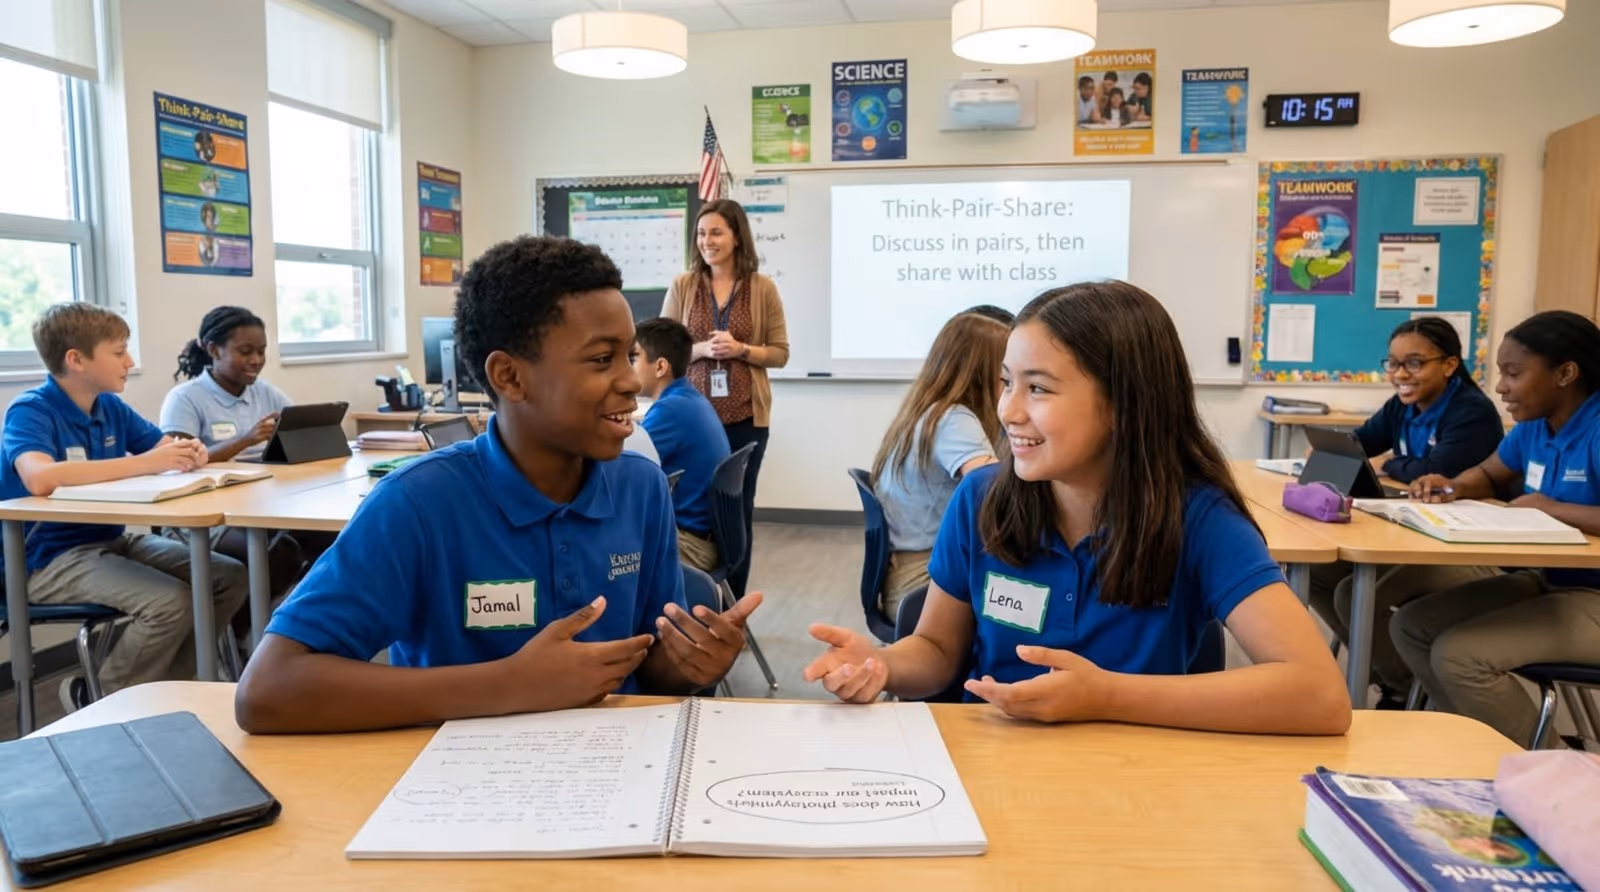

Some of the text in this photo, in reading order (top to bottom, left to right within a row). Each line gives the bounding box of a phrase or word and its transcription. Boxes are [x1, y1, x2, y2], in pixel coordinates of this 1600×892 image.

[834, 62, 905, 80] SCIENCE
[882, 197, 1074, 218] Think-Pair-Share:
[872, 233, 1085, 254] Discuss in pairs, then
[897, 262, 1057, 281] share with class
[471, 594, 520, 613] Jamal
[989, 587, 1023, 611] Lena
